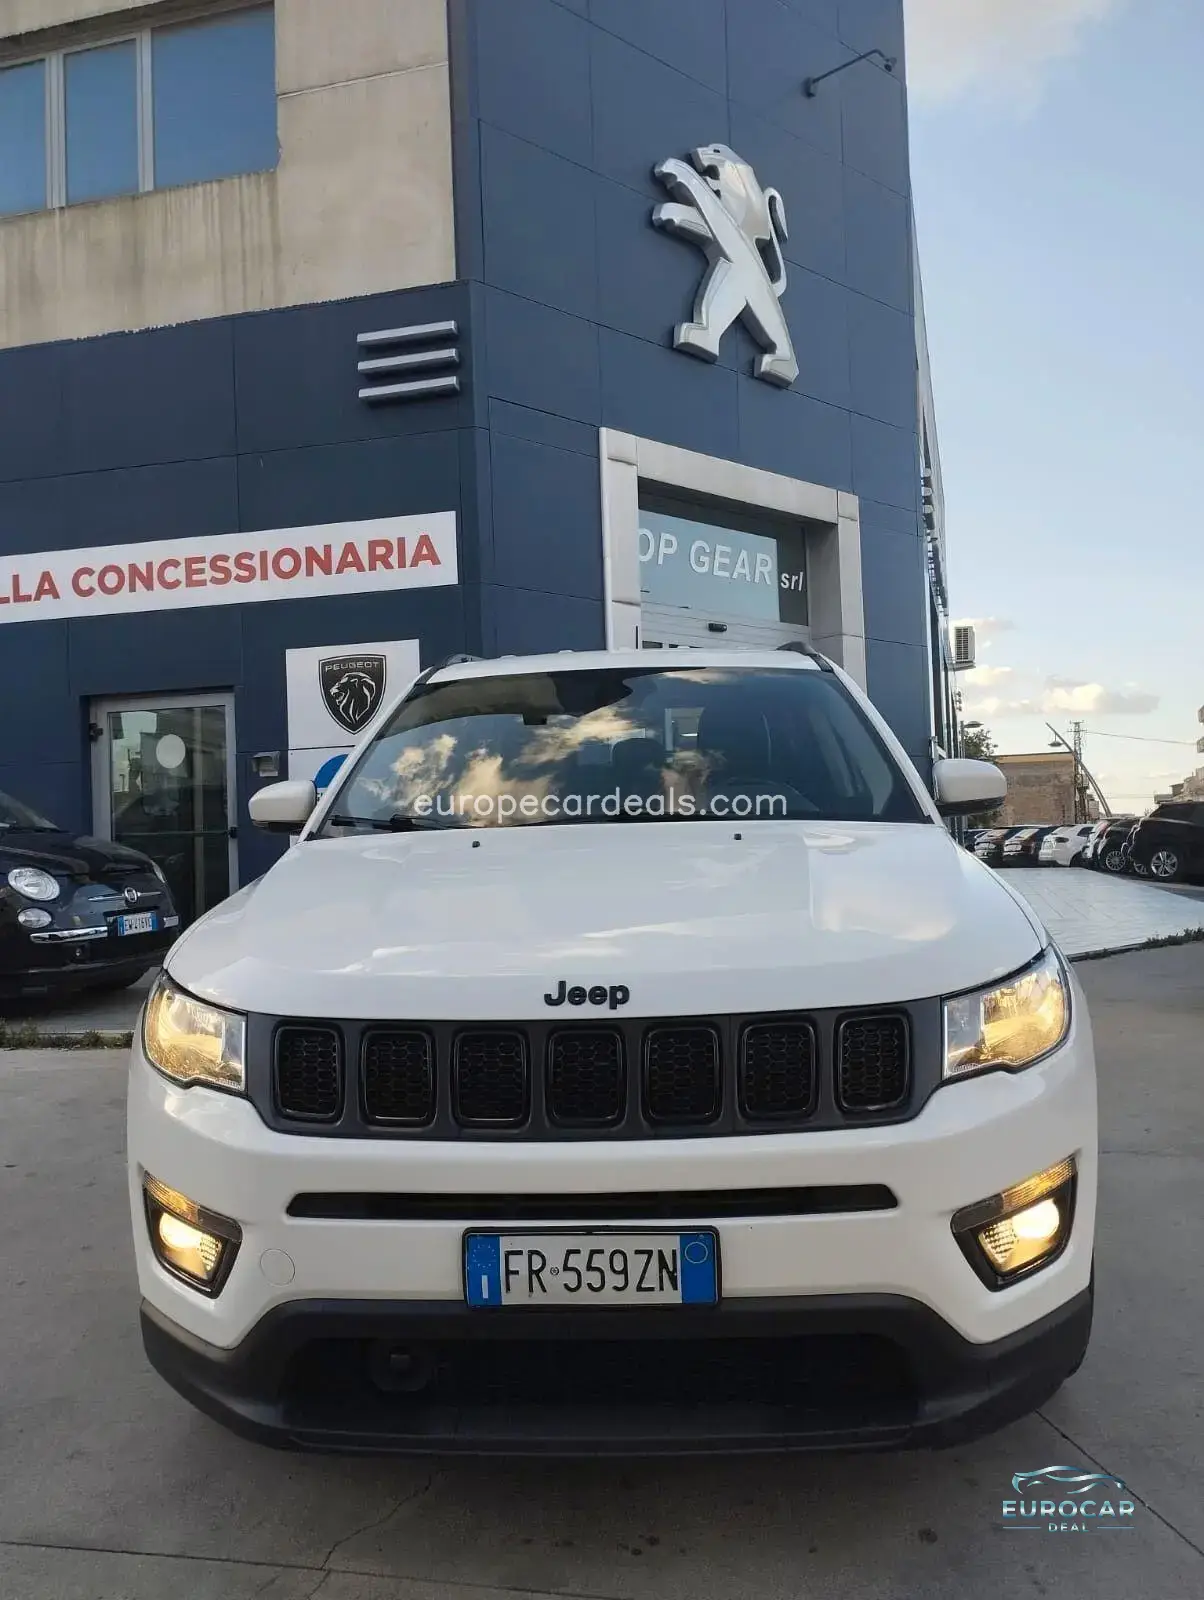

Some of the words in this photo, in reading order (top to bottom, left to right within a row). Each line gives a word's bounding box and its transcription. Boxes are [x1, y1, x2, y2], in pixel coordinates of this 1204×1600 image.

[0, 570, 60, 604] LA
[71, 534, 442, 598] CONCESSIONARIA
[689, 540, 773, 585] GEAR
[780, 571, 804, 591] srl
[325, 661, 380, 673] PEUGEOT
[543, 980, 630, 1010] Jeep
